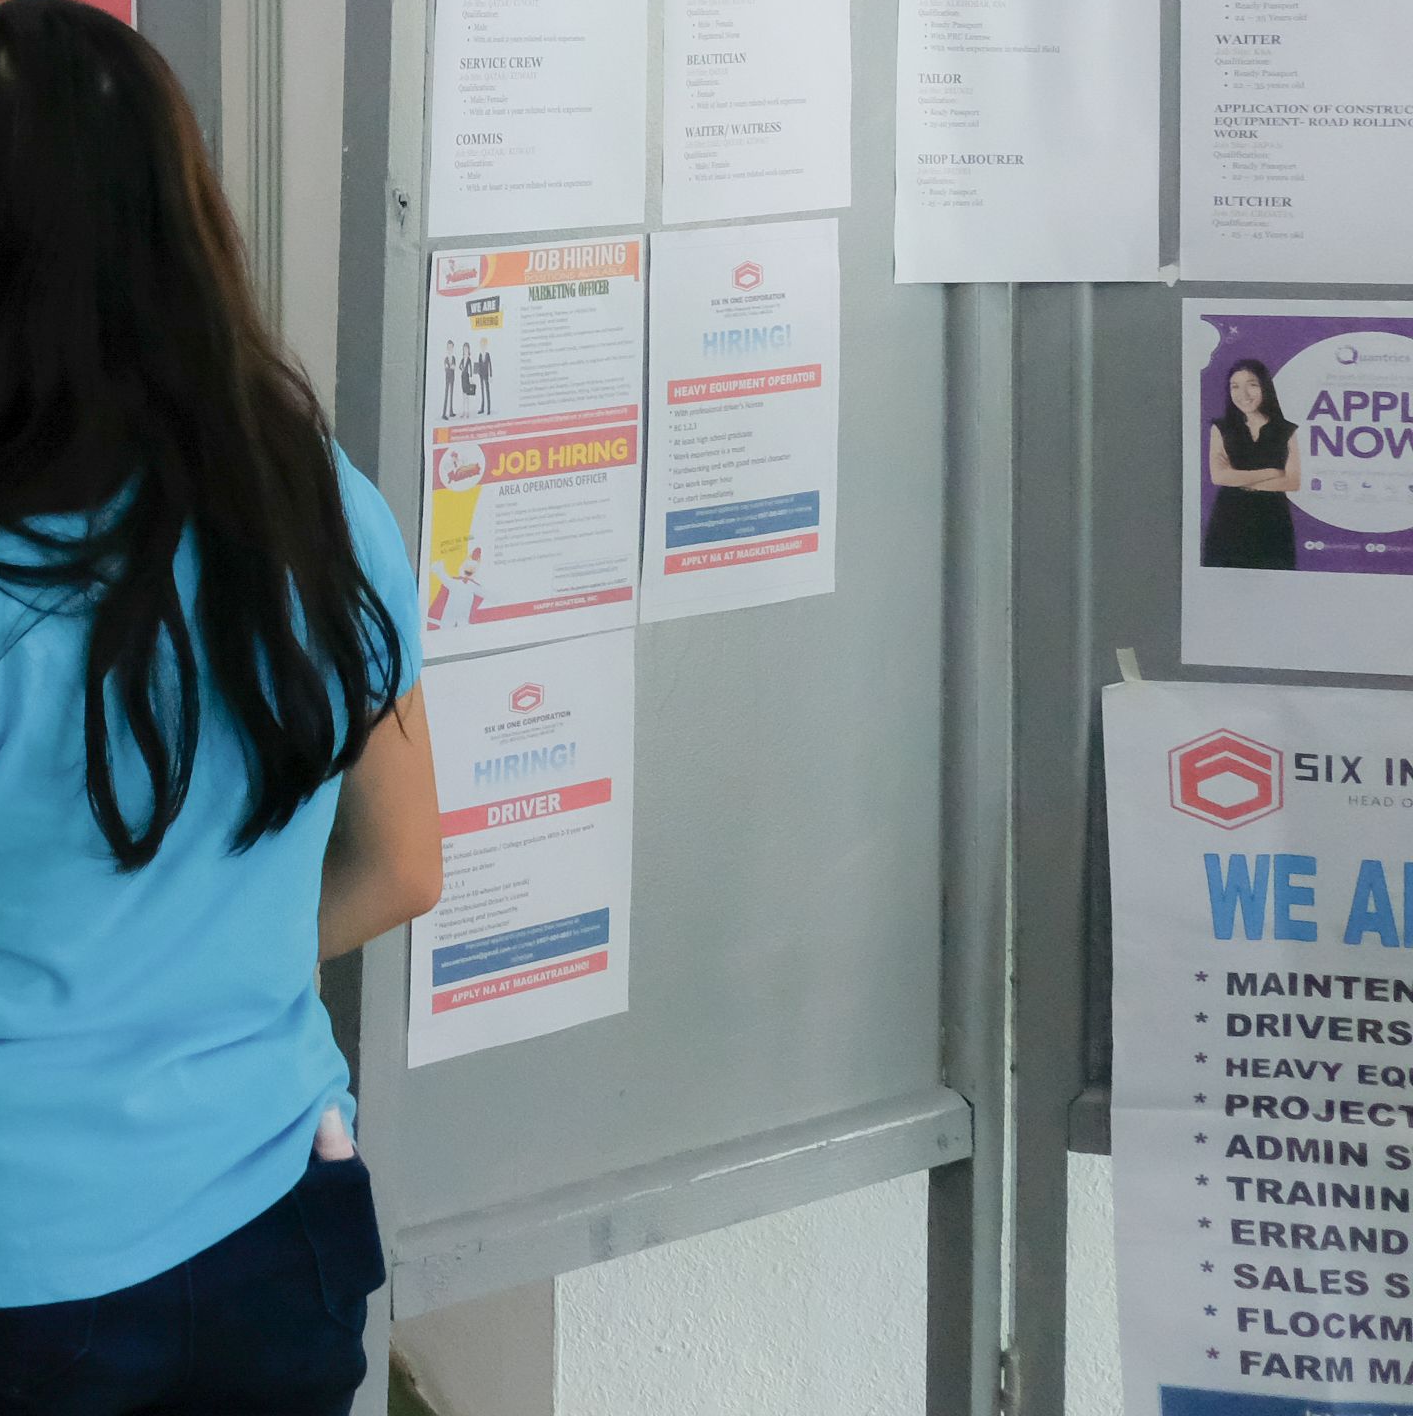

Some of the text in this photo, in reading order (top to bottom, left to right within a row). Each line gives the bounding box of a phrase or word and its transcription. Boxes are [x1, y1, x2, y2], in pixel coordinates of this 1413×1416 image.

[460, 56, 543, 70] SERVICE CREW
[687, 53, 746, 65] BEAUTICIAN
[918, 73, 962, 84] TAILOR
[456, 133, 503, 145] COMMIS
[1214, 196, 1292, 207] BUTCHER
[525, 243, 627, 273] JOB HIRING
[703, 324, 791, 358] HIRING!
[674, 372, 815, 398] HEAVY EQUIPMENT OPERATOR
[491, 437, 628, 476] JOB HIRING
[499, 472, 607, 496] AREA OPERATIONS OFFICER
[474, 742, 576, 784] HIRING!
[1295, 753, 1362, 784] SIX
[487, 793, 561, 827] DRIVER
[1204, 853, 1317, 942] WE
[1227, 1013, 1413, 1045] DRIVERS
[1226, 1058, 1343, 1082] HEAVY
[1226, 1134, 1368, 1167] ADMIN
[1226, 1176, 1409, 1213] TRAININ
[1231, 1219, 1409, 1255] ERRAND
[1233, 1263, 1369, 1296] SALES
[1237, 1307, 1413, 1342] FLOCKM
[1240, 1350, 1354, 1382] FARM
